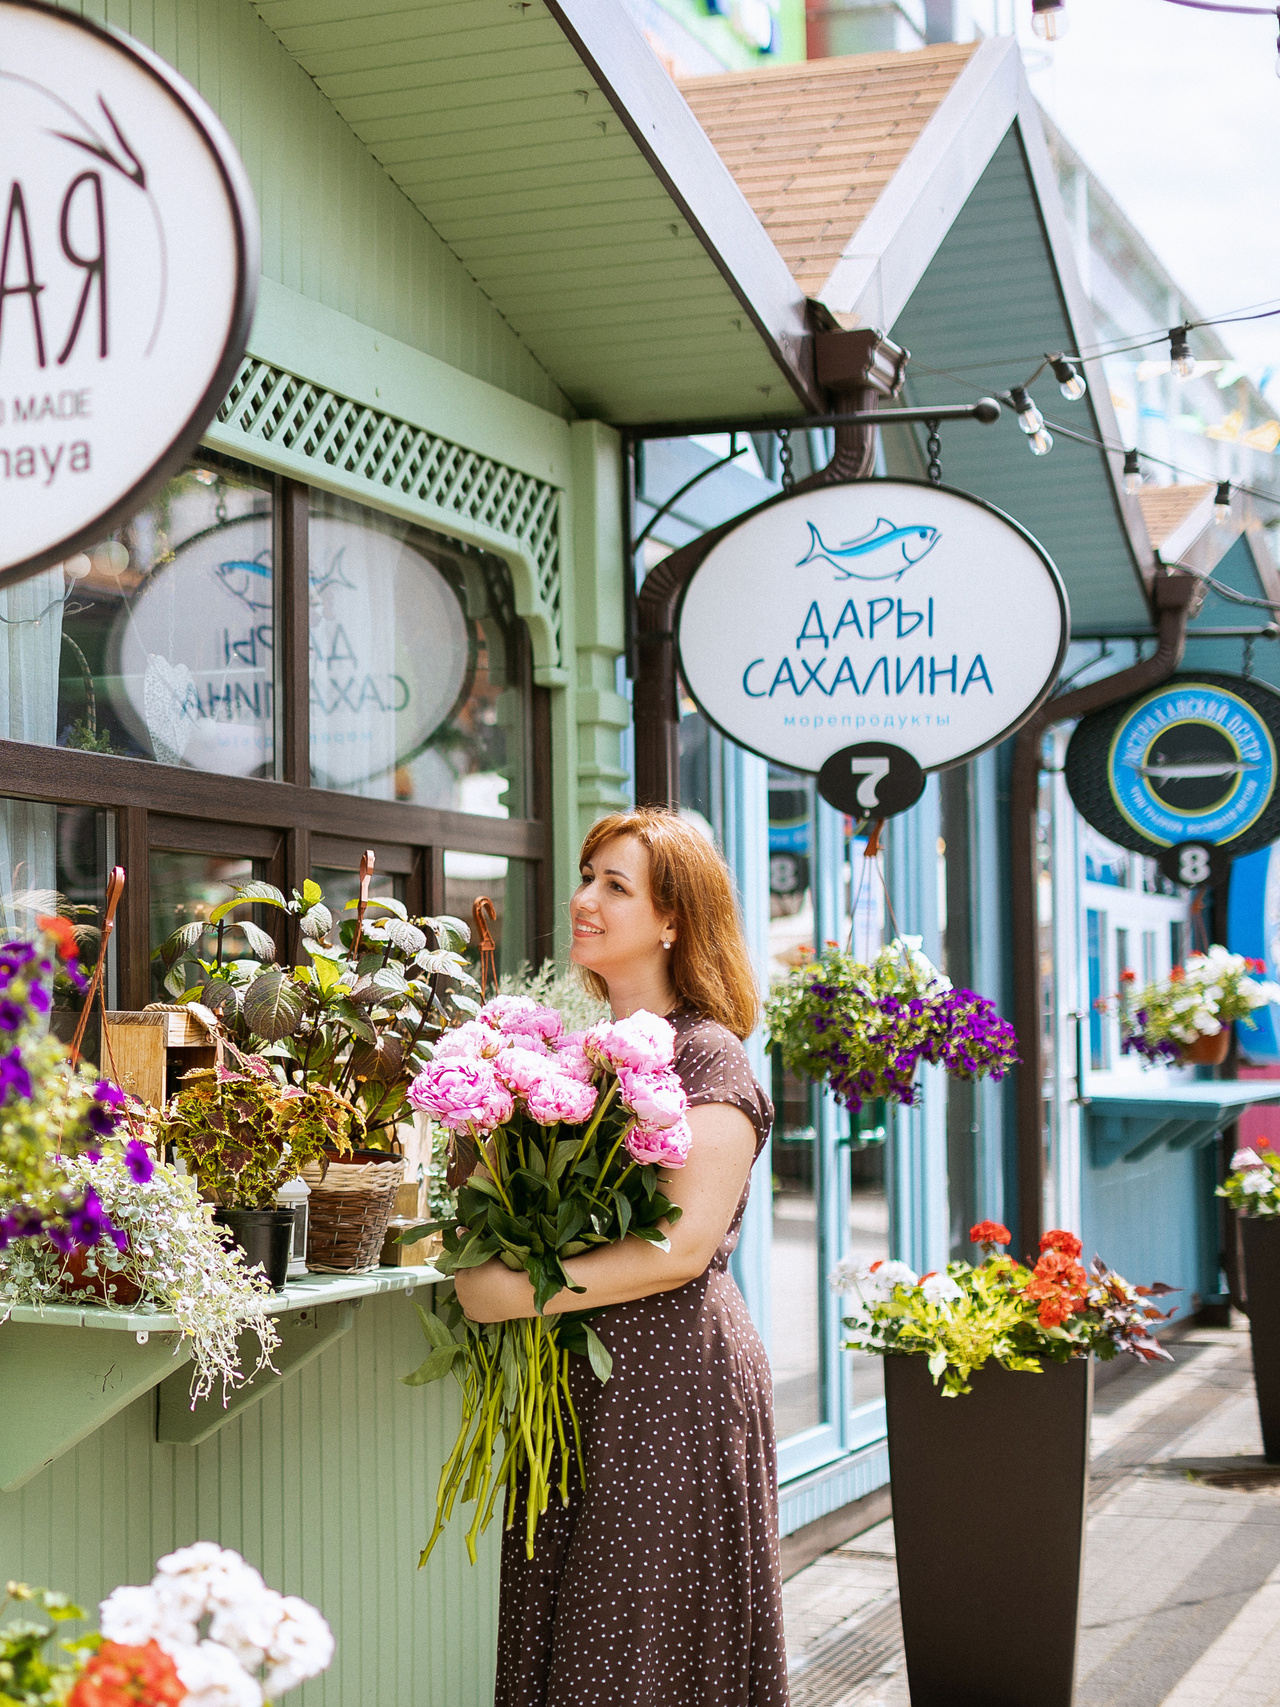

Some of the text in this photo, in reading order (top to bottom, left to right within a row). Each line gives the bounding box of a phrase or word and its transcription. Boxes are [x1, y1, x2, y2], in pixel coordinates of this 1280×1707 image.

[13, 387, 93, 421] MADE
[796, 597, 933, 650] ДАРЫ
[742, 654, 994, 697] САХАЛИНА
[784, 714, 950, 729] морепродукты
[851, 757, 890, 808] 7
[1179, 845, 1211, 884] 8
